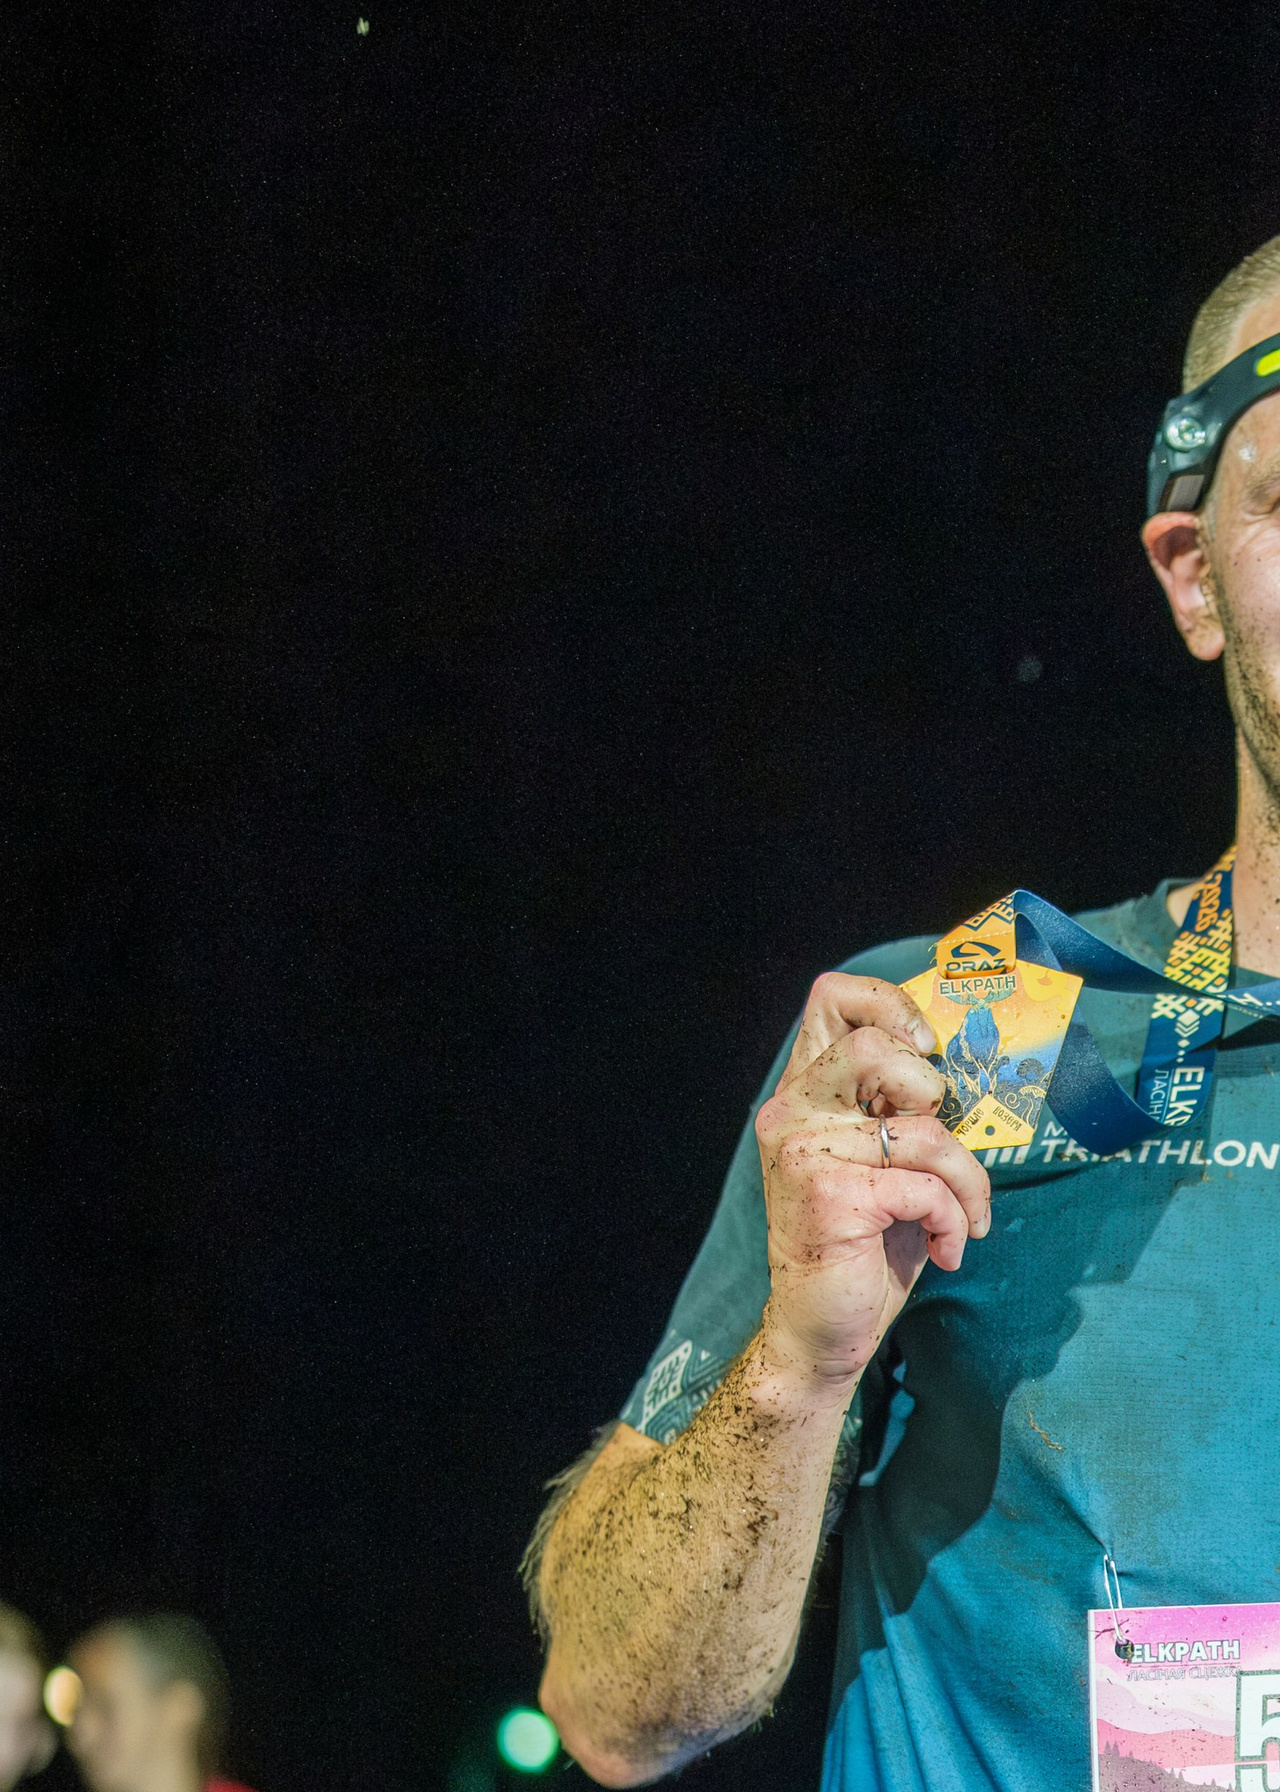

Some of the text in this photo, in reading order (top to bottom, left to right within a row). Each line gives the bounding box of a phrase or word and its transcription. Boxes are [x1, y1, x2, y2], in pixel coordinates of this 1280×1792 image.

[946, 958, 1006, 972] ORAZ
[940, 976, 1016, 995] ELKPATH
[1130, 1639, 1241, 1663] ELKPATH
